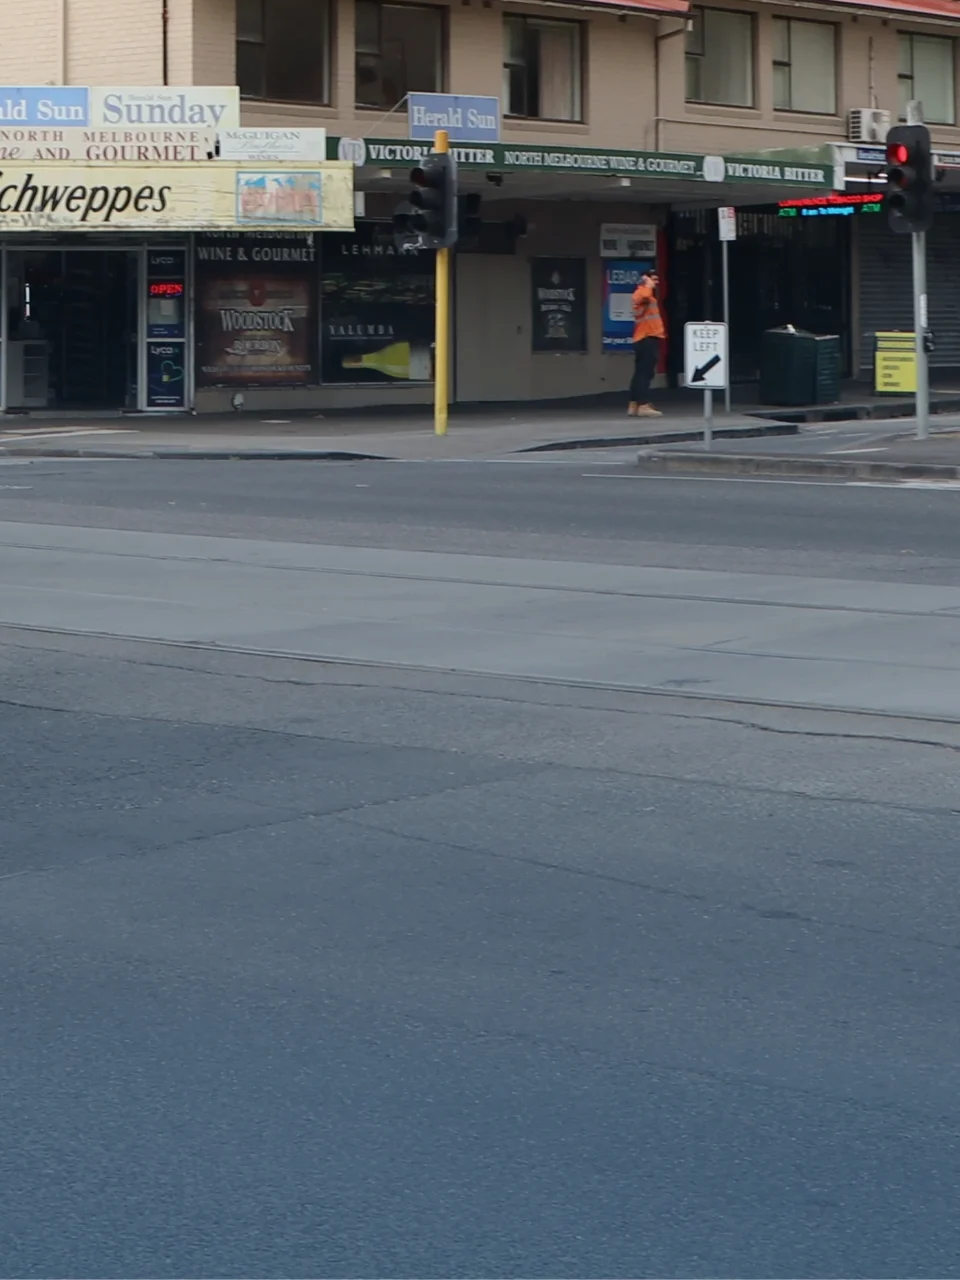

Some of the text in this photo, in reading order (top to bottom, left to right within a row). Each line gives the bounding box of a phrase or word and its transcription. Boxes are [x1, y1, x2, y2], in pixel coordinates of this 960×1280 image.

[37, 100, 85, 121] Sun
[103, 93, 227, 128] Sunday
[412, 106, 496, 129] Herald Sun
[0, 130, 199, 143] NORTH MELBOURNE
[226, 131, 300, 140] McGUIGAN
[34, 147, 70, 160] AND
[86, 145, 200, 161] GOURMET
[504, 151, 542, 166] NORTH
[544, 153, 608, 169] MELBOURNE
[609, 156, 637, 170] WINE
[637, 158, 646, 170] &
[646, 158, 696, 174] GOURMET
[726, 163, 782, 179] VICTORIA
[784, 167, 825, 183] BITTER
[779, 208, 797, 217] ATM
[861, 204, 881, 212] ATM
[198, 246, 316, 262] WINE & GOURMET
[150, 284, 183, 294] OPEN
[220, 310, 295, 331] WOODSTOCK
[692, 329, 719, 338] KEEP
[692, 341, 718, 352] LEFT
